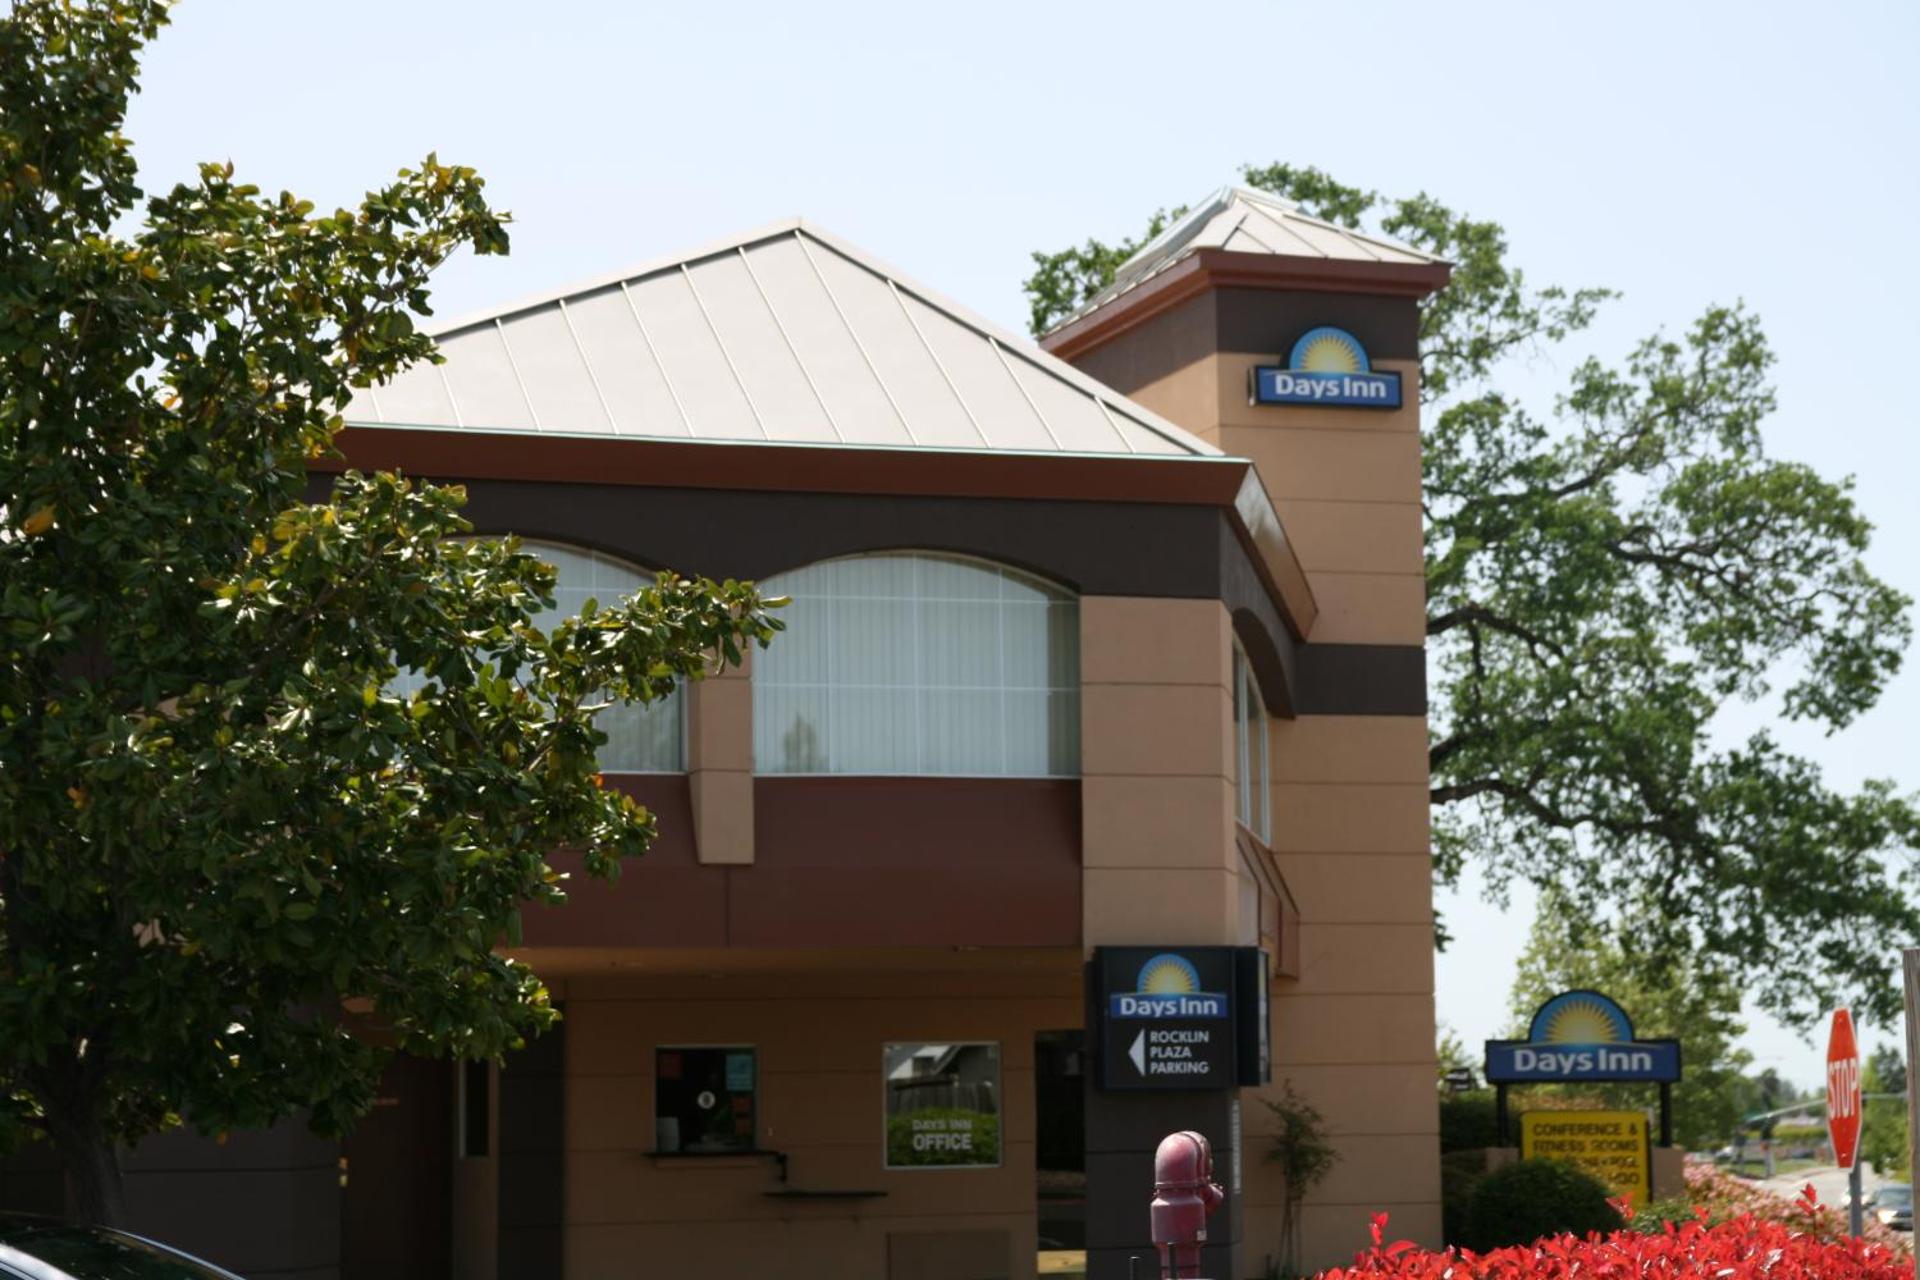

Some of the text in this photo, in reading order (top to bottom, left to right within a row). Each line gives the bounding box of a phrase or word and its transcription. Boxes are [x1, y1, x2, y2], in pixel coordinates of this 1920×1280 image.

[1275, 374, 1387, 399] Days Inn
[1120, 997, 1218, 1018] Days Inn
[1150, 1030, 1210, 1043] ROCKLIN
[1150, 1046, 1192, 1059] PLAZA
[1150, 1061, 1209, 1075] PARKING
[1514, 1049, 1652, 1075] Days Inn
[1829, 1057, 1858, 1121] STOP
[912, 1119, 972, 1131] DAYS INN
[1533, 1123, 1622, 1136] CONFERENCE
[913, 1133, 972, 1150] OFFICE
